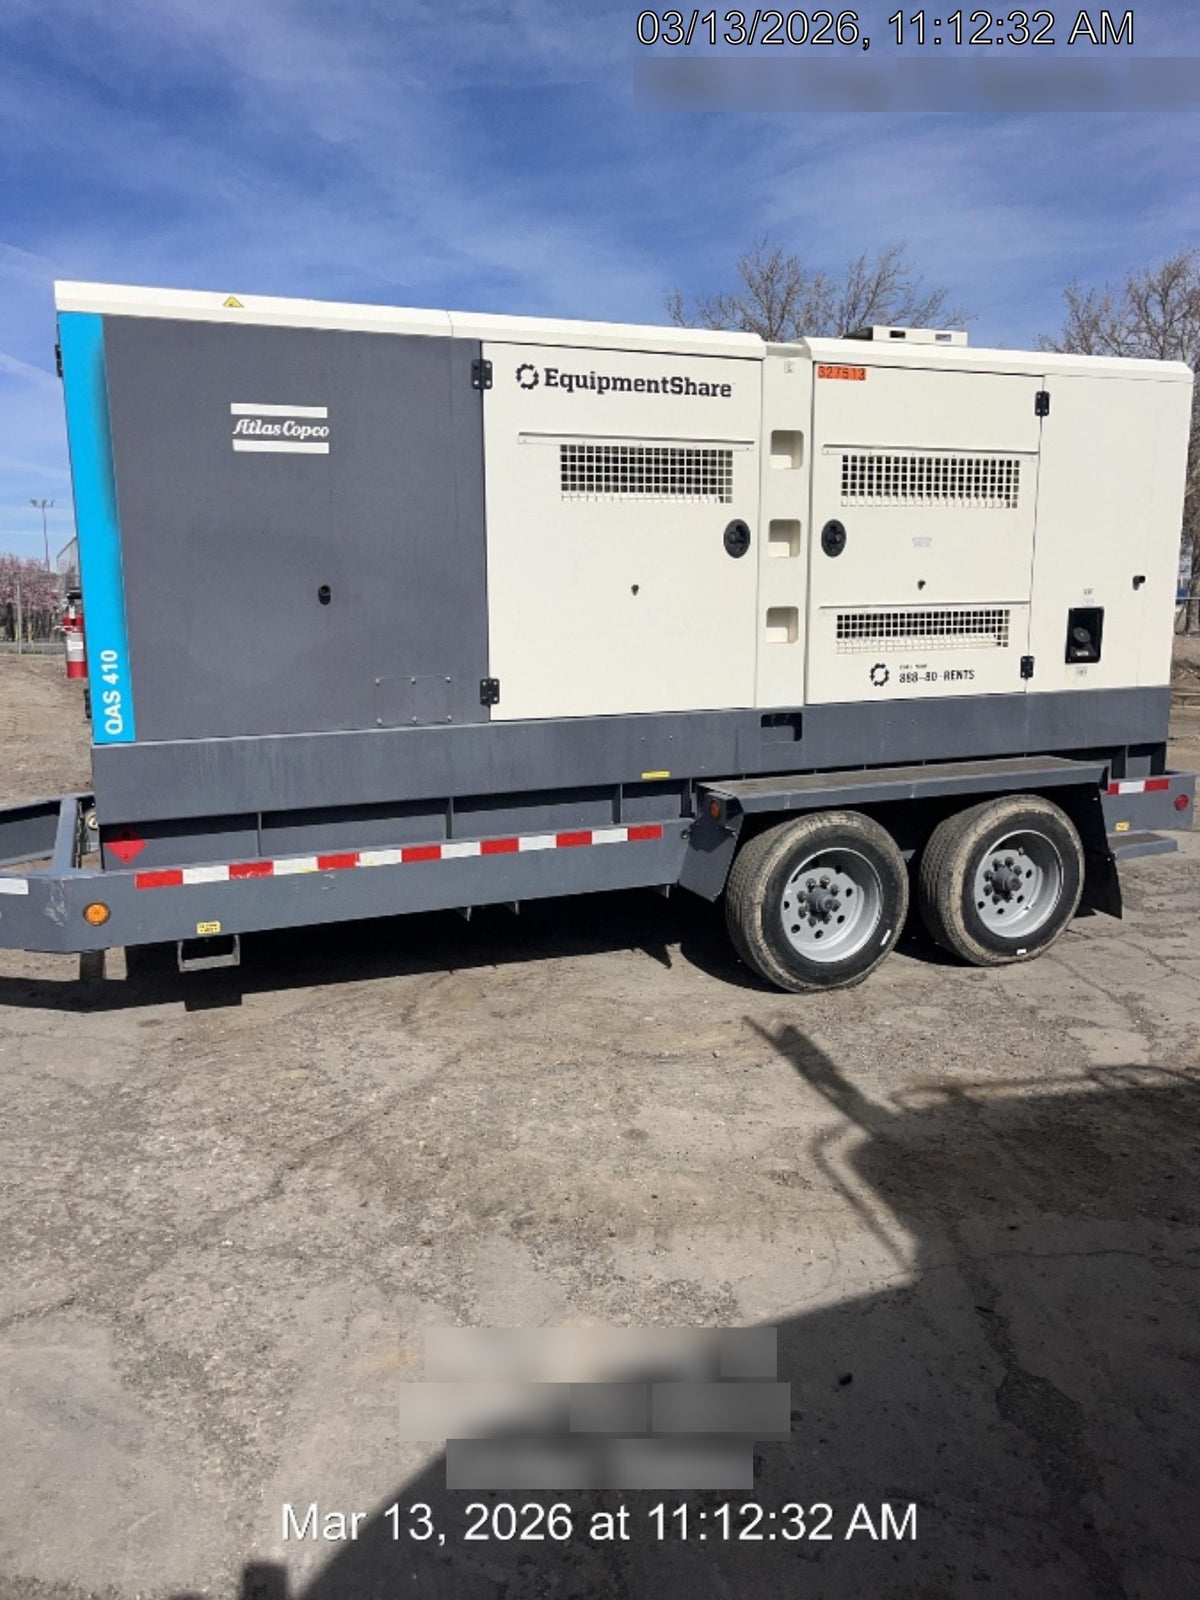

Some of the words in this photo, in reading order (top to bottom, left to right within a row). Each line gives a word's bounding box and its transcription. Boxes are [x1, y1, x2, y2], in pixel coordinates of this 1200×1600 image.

[543, 367, 732, 398] EquipmentShare
[232, 418, 281, 435] Atlas
[282, 420, 330, 440] Copco
[100, 649, 119, 685] 410
[103, 690, 123, 735] QAS
